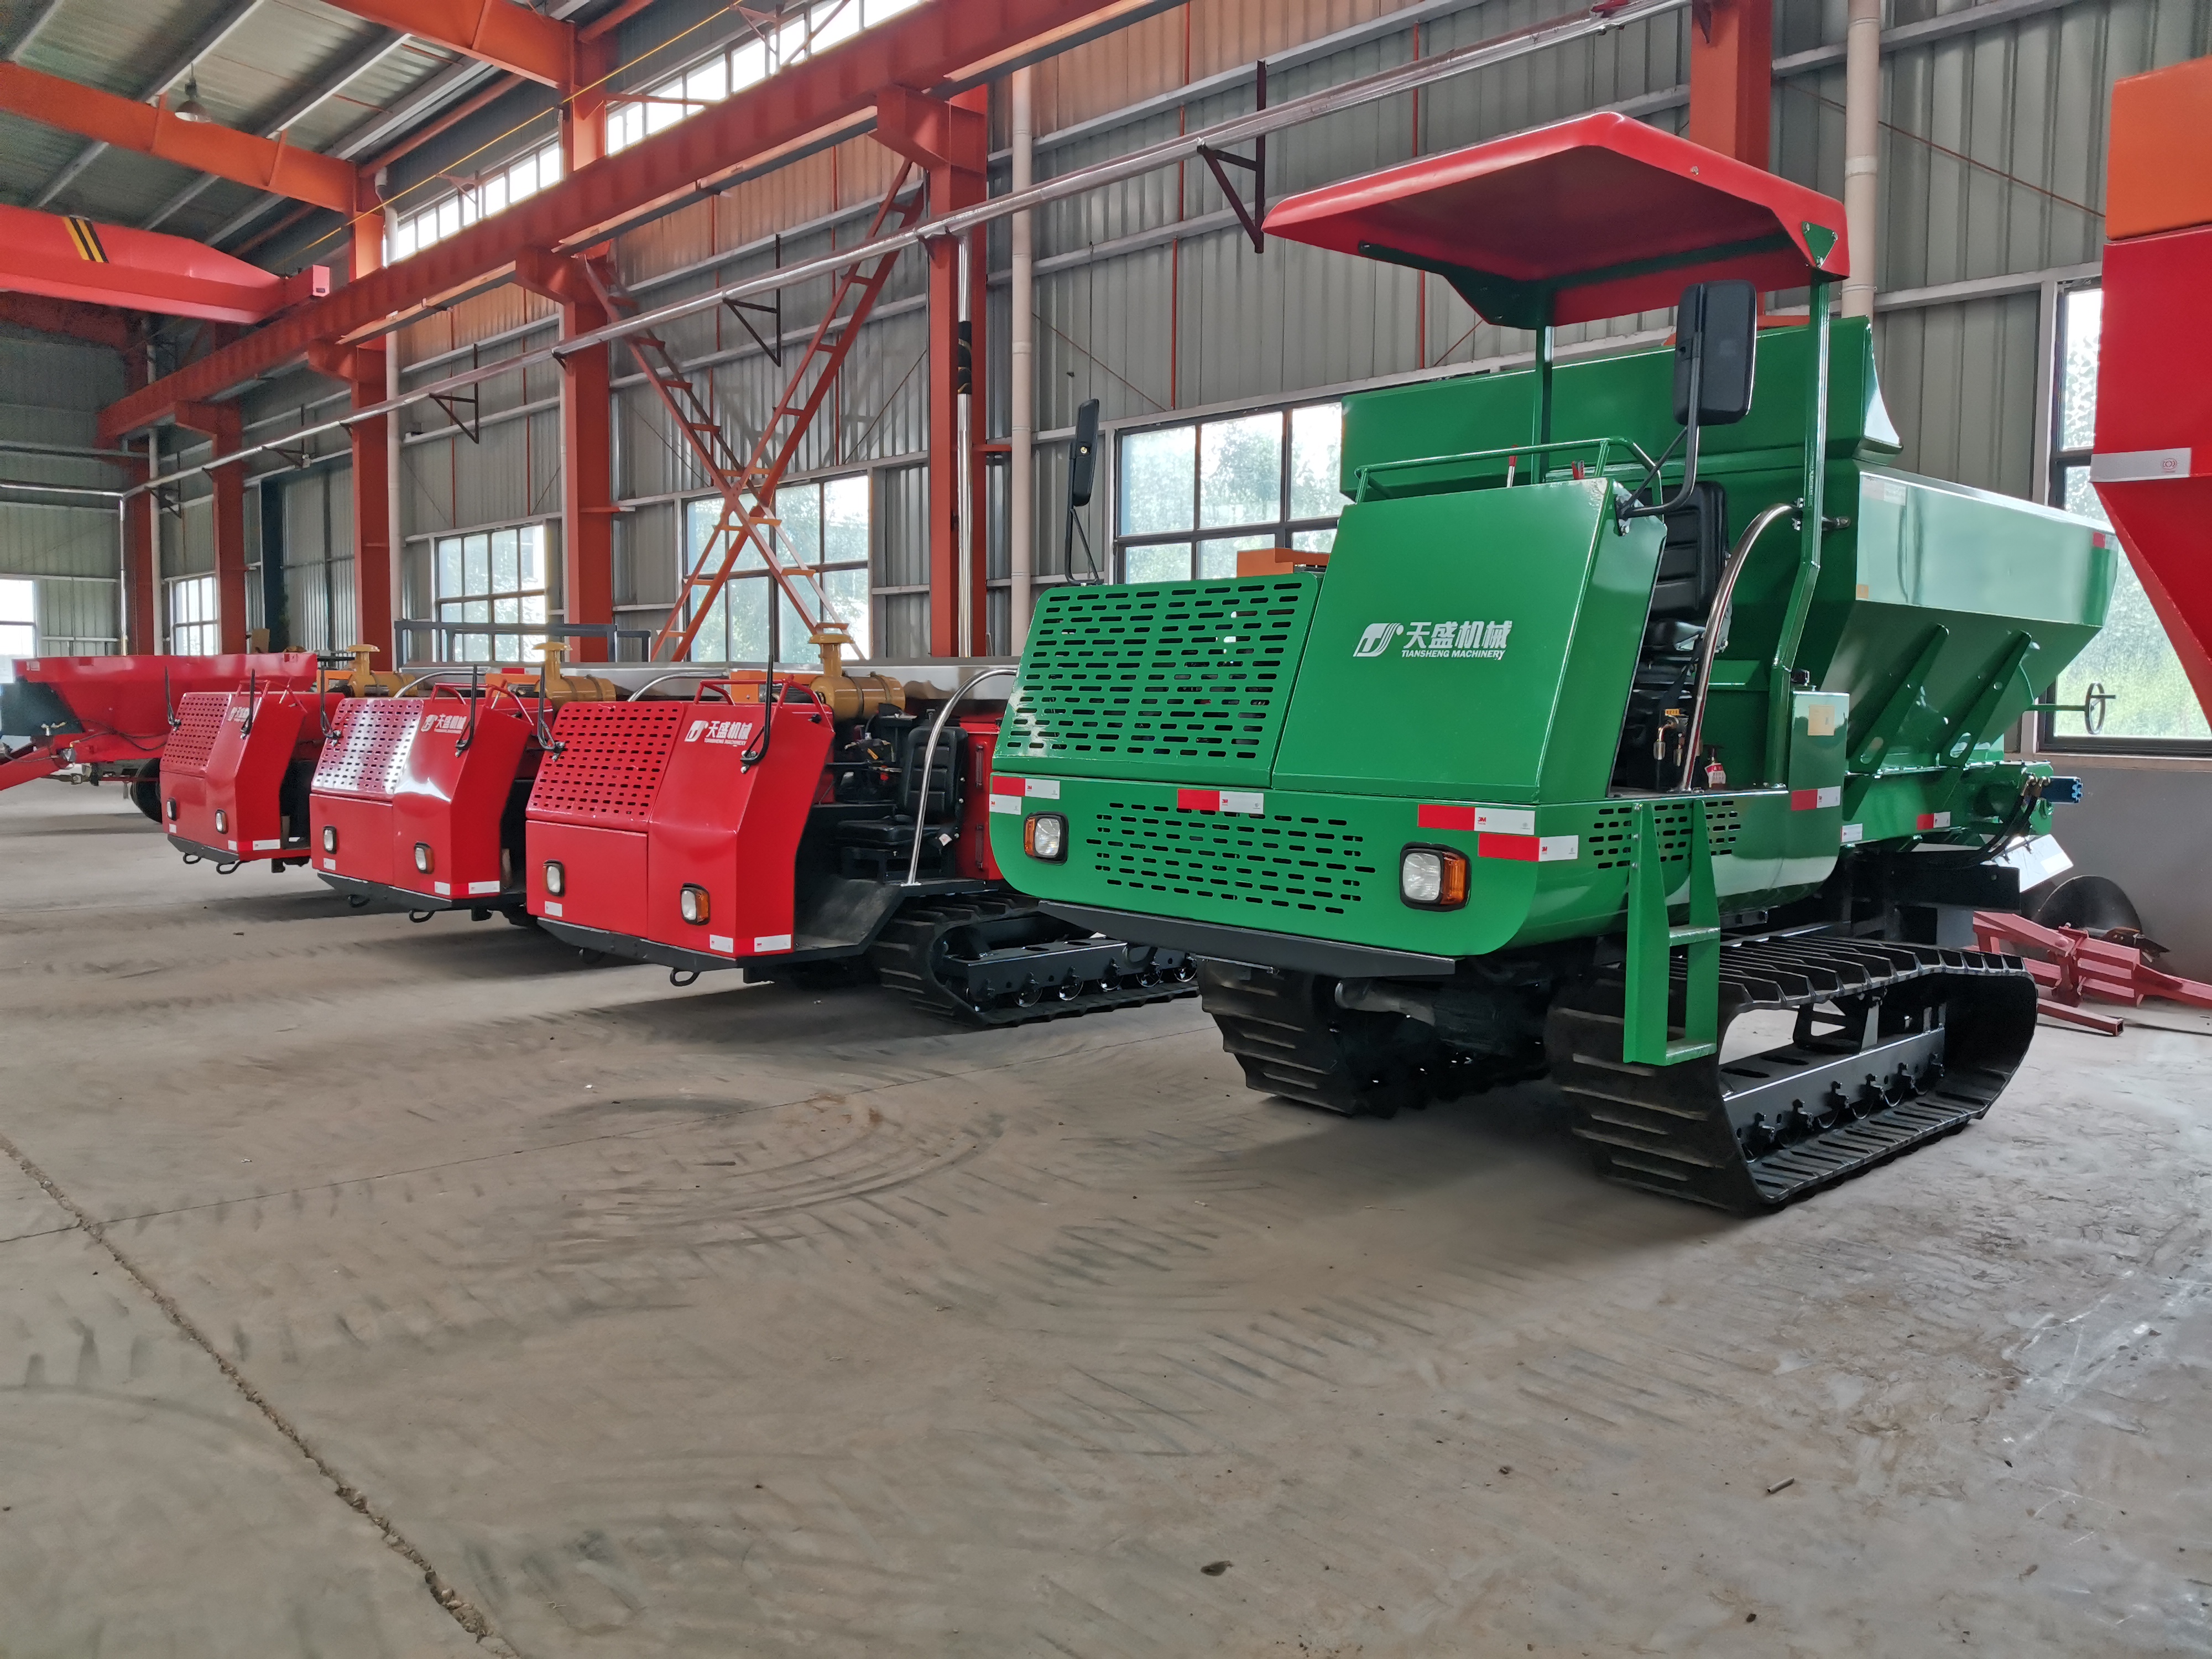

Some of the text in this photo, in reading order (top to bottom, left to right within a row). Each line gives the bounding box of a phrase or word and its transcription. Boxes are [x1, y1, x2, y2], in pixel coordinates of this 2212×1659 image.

[1403, 620, 1513, 649] 天盛机械
[1401, 649, 1506, 660] TIANSHENG MACHINERY
